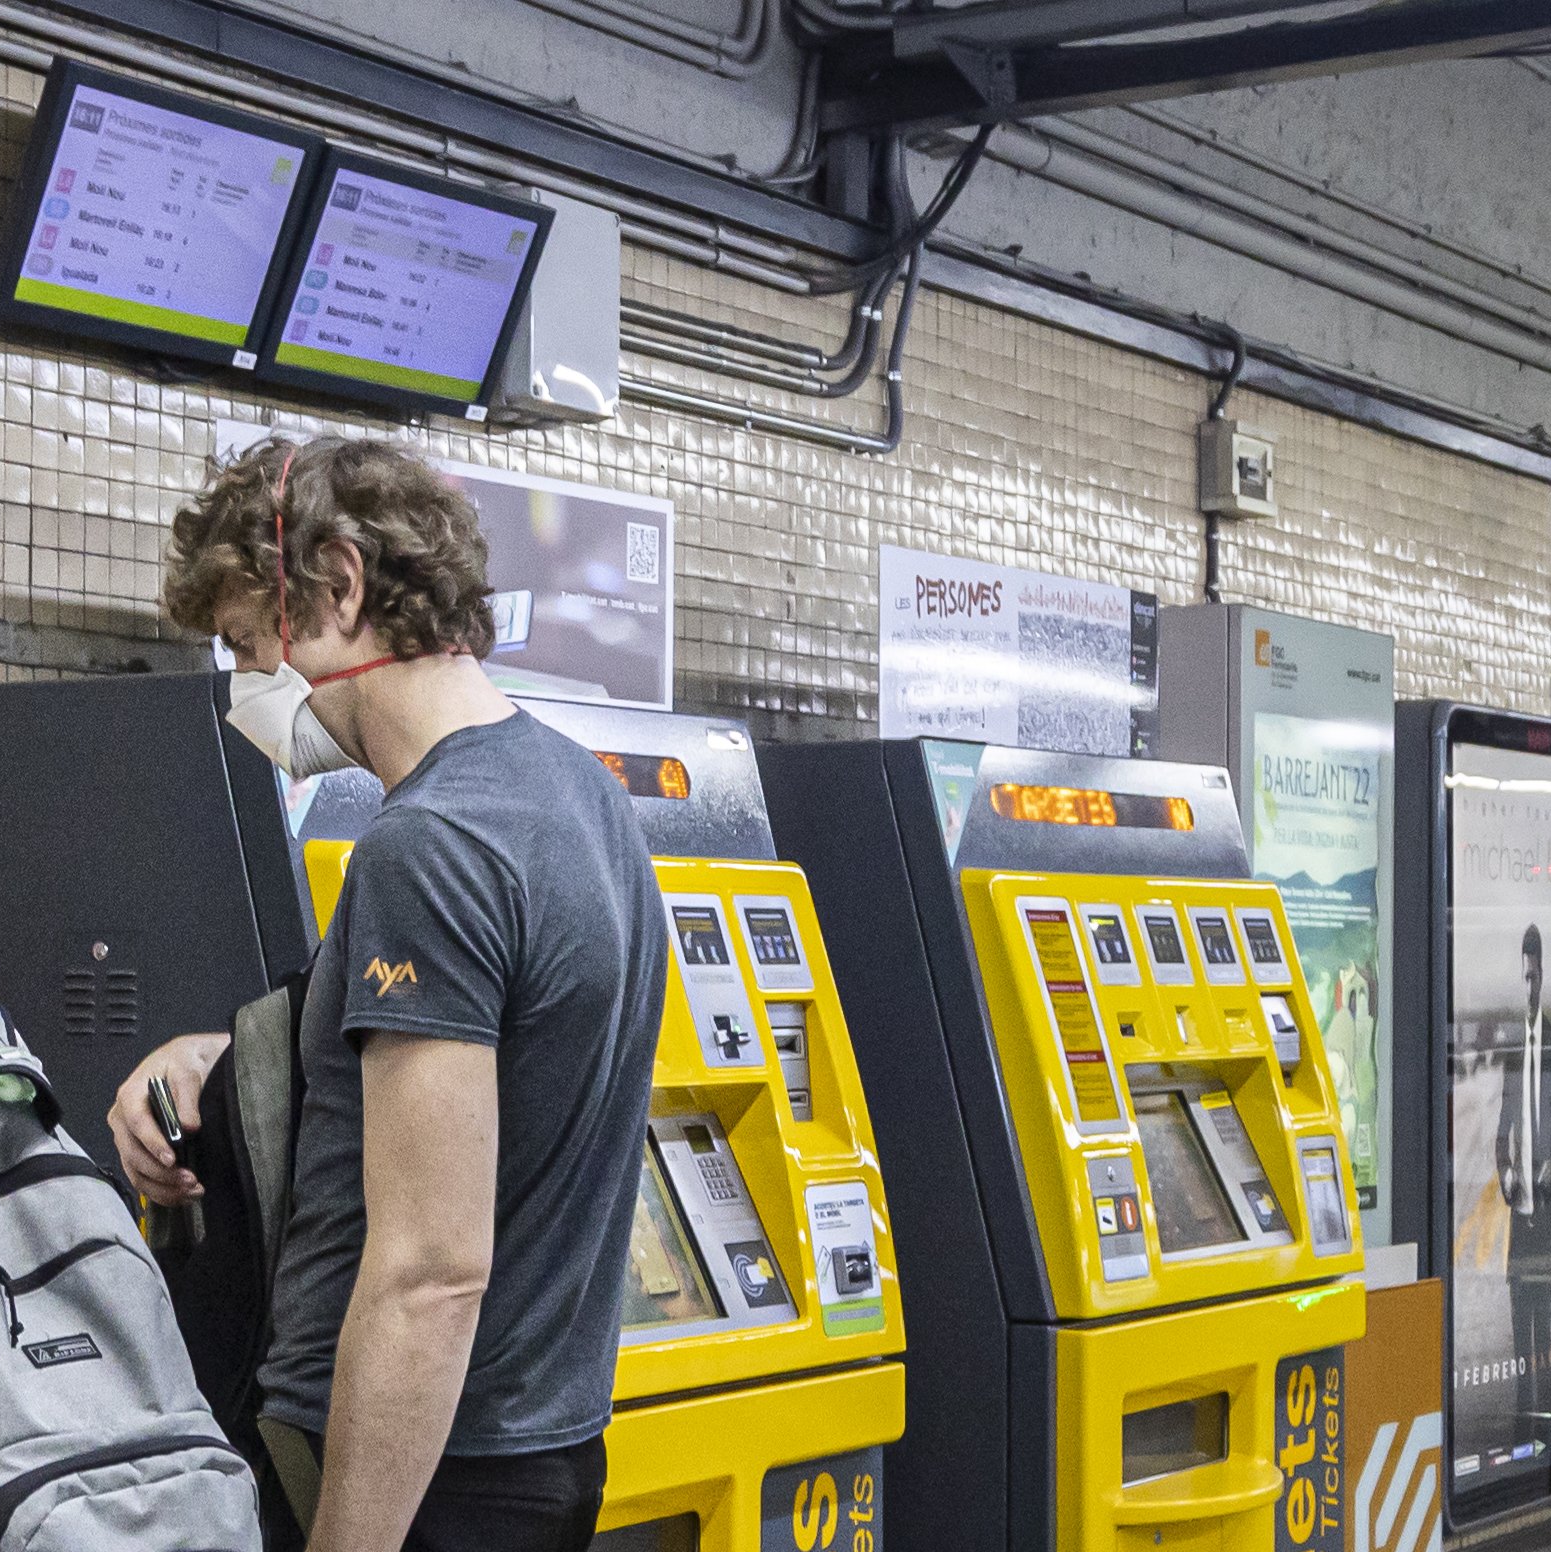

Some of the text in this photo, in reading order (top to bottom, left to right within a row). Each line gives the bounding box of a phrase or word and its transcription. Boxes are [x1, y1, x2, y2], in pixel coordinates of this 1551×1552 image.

[915, 574, 1003, 619] PERSONES
[1463, 1356, 1527, 1388] FEBRERO
[1320, 1366, 1340, 1538] Tickets
